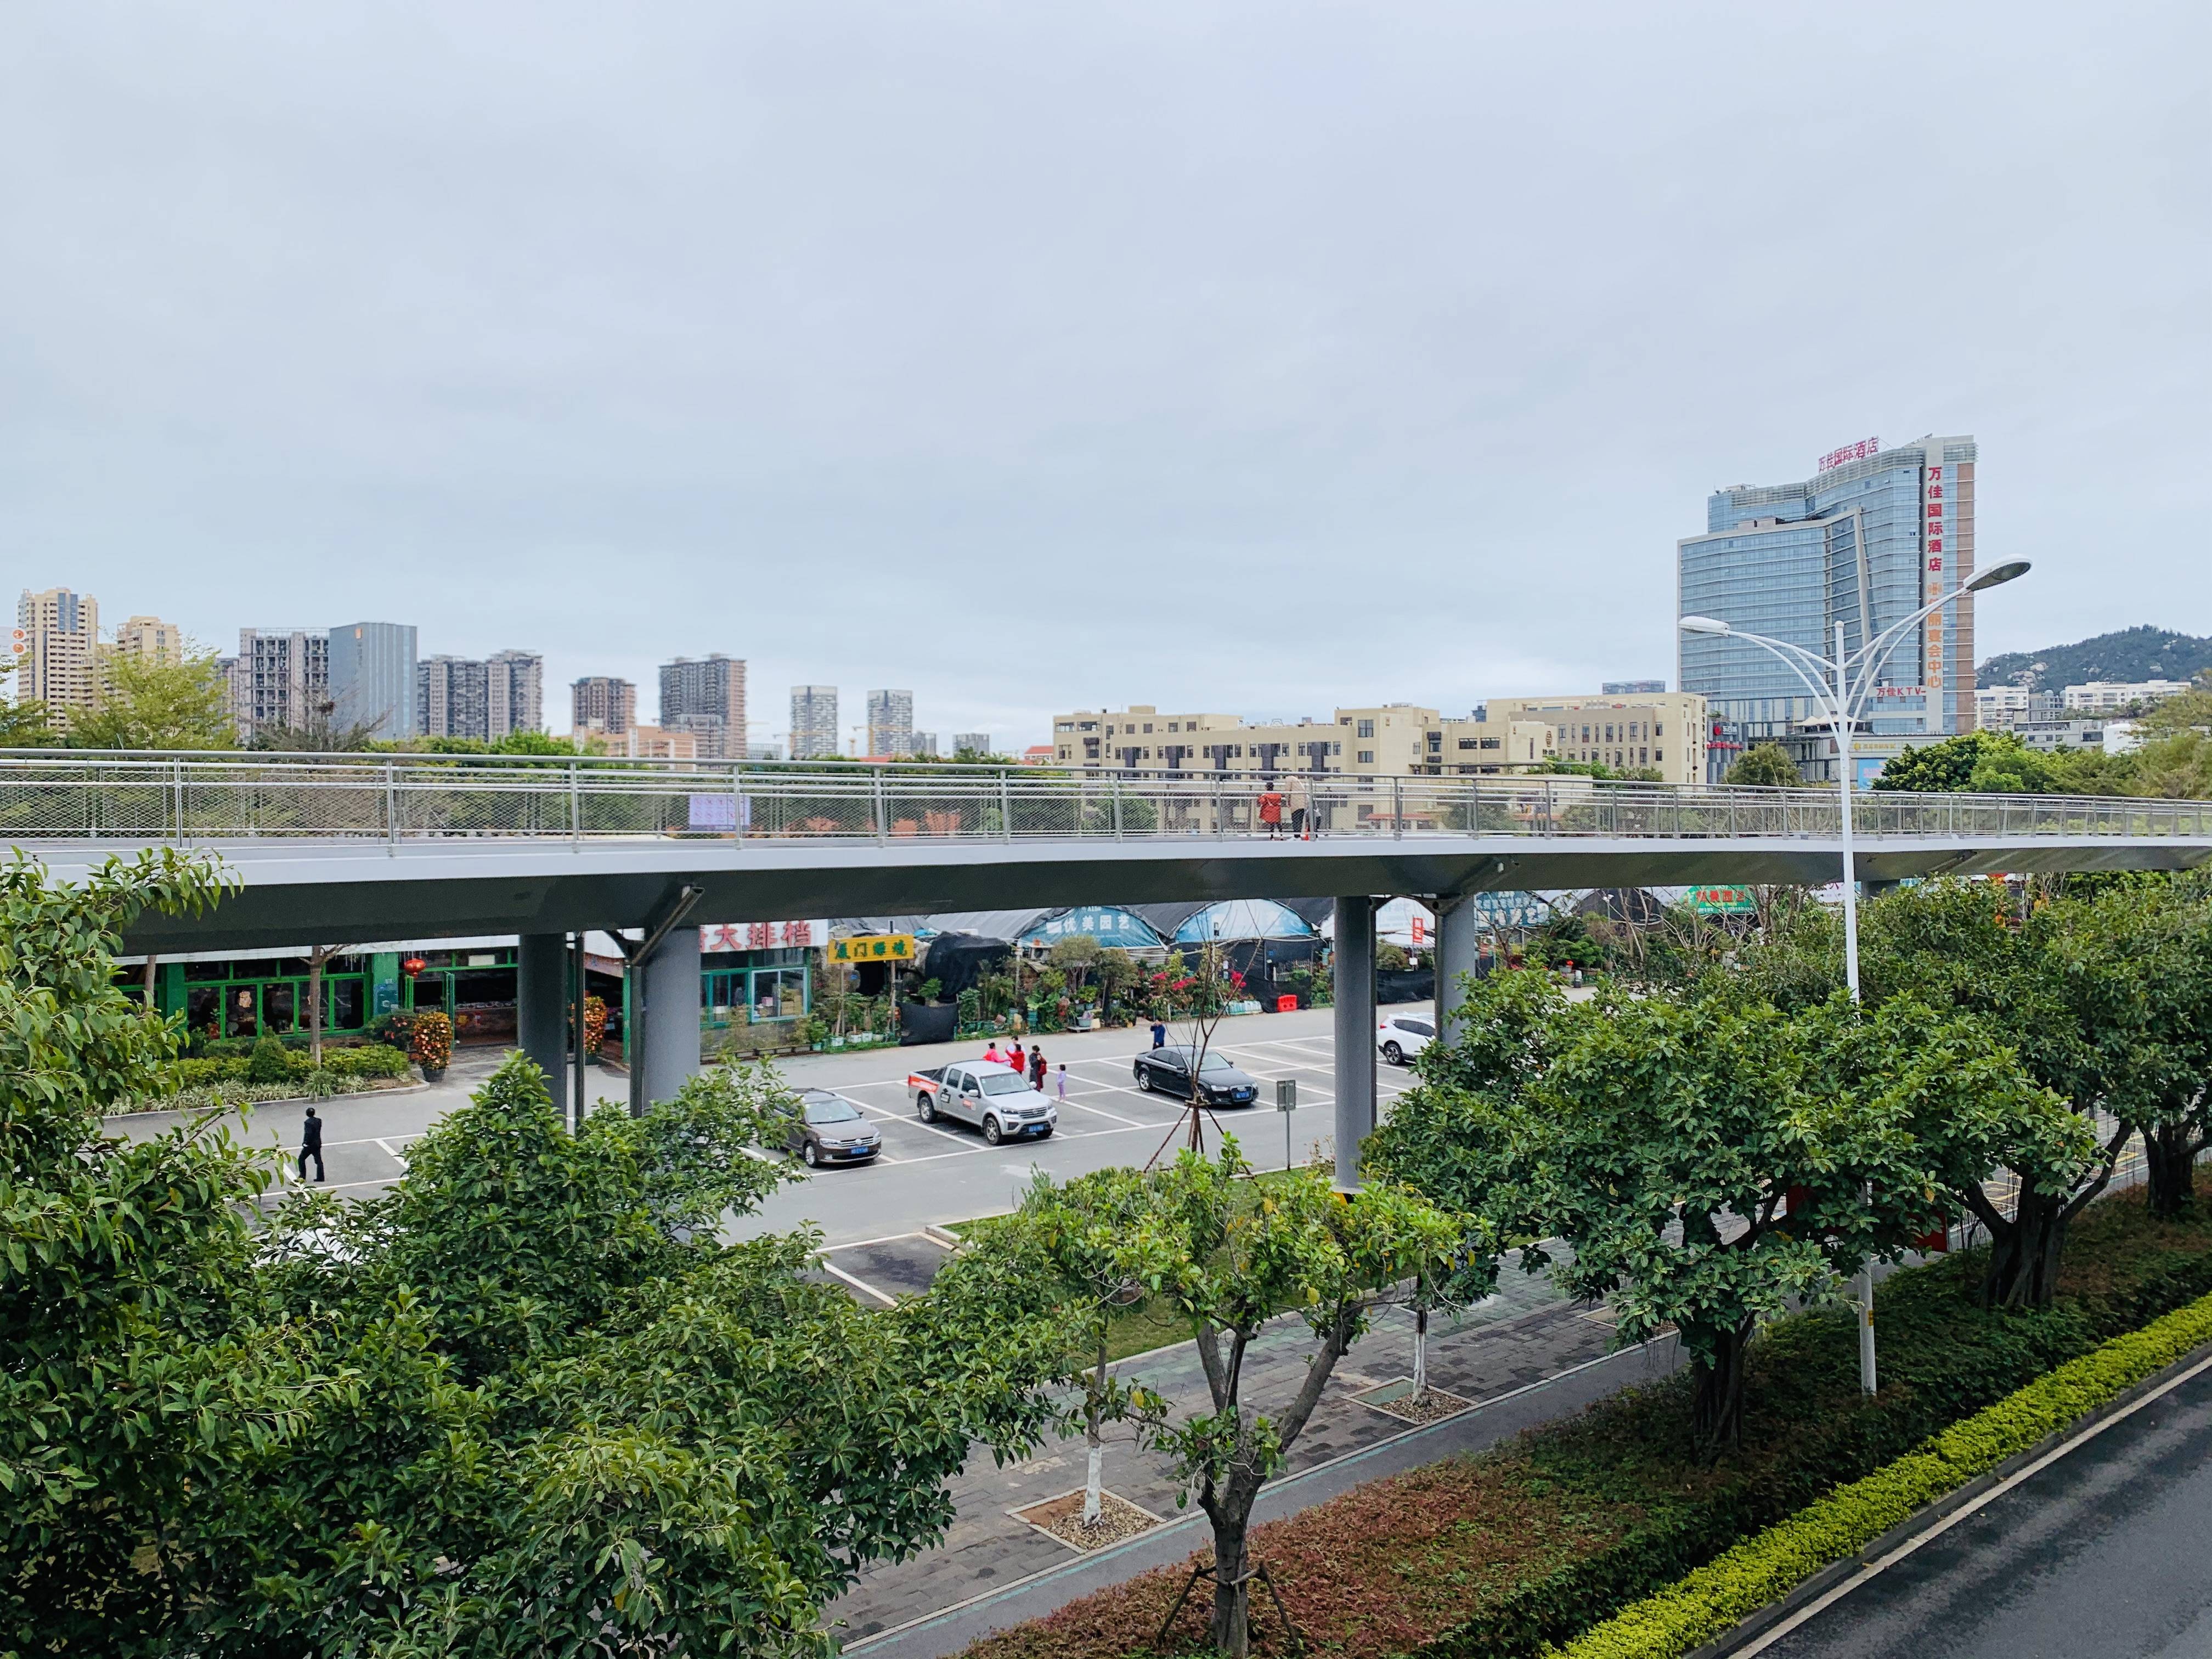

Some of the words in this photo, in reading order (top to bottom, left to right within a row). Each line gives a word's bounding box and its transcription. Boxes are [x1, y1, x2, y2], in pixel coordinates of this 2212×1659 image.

[1819, 436, 1878, 472] 万佳国际酒店
[1928, 467, 1943, 571] 万佳国际酒店
[1064, 913, 1130, 933] 优美园艺
